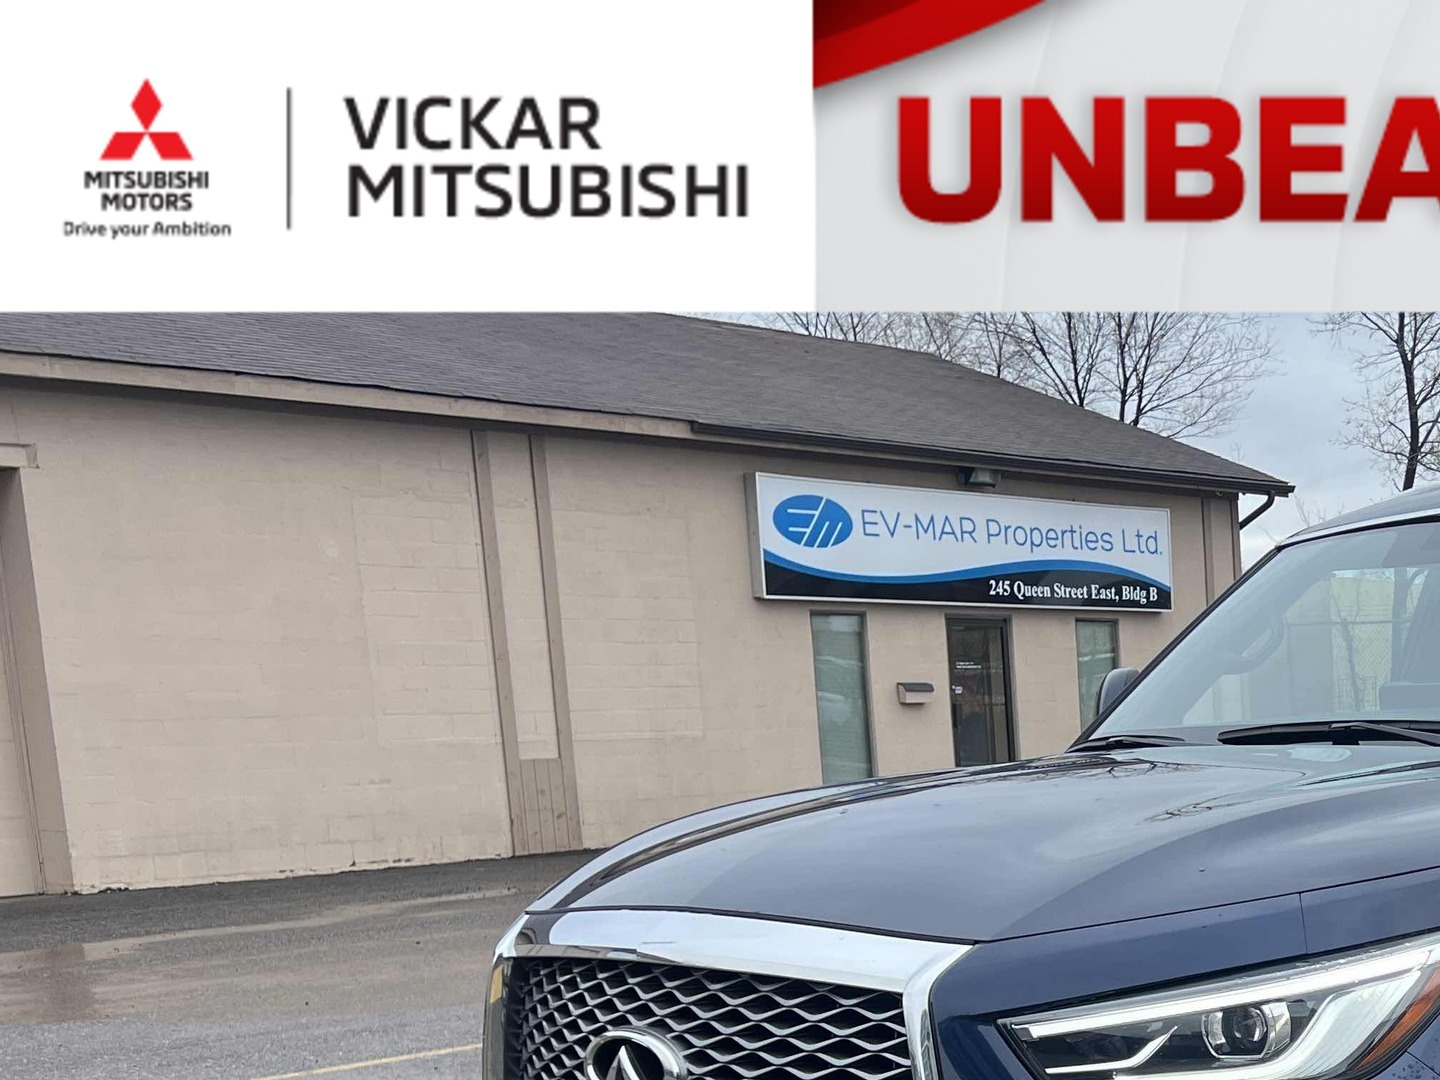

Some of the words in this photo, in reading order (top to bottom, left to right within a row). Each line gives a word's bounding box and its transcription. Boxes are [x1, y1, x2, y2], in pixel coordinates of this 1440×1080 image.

[861, 509, 978, 543] EV-MAR
[985, 518, 1114, 553] Properties
[1121, 528, 1163, 555] Ltd.
[989, 579, 1011, 596] 245
[1013, 580, 1052, 600] Queen
[1053, 582, 1089, 599] Street
[1090, 584, 1120, 603] East,
[1121, 585, 1147, 604] Bldg
[1149, 586, 1158, 601] B
